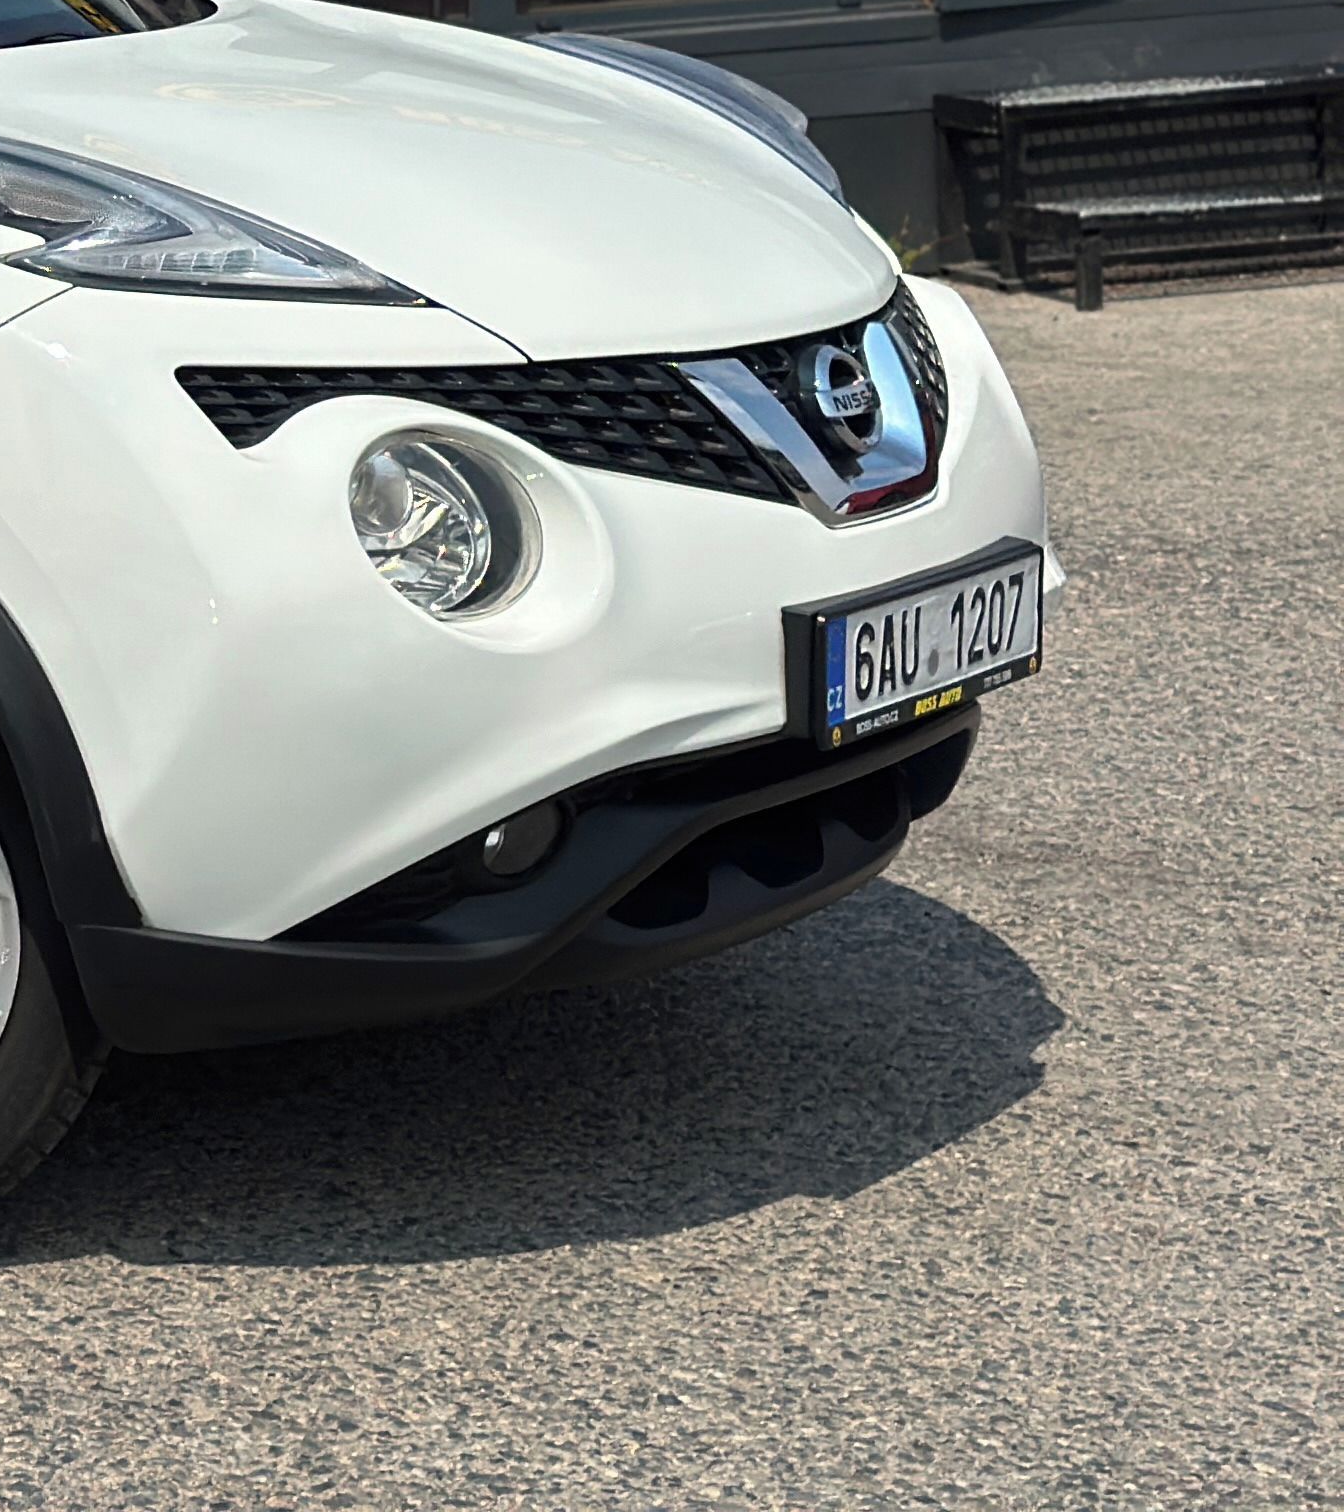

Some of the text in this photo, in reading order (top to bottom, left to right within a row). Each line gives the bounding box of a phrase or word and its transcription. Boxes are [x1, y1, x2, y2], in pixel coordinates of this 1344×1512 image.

[832, 390, 871, 412] NISS
[854, 570, 1025, 702] 6AU 1207
[826, 685, 843, 712] CZ
[914, 694, 938, 717] BOSS
[938, 685, 963, 711] AUTO
